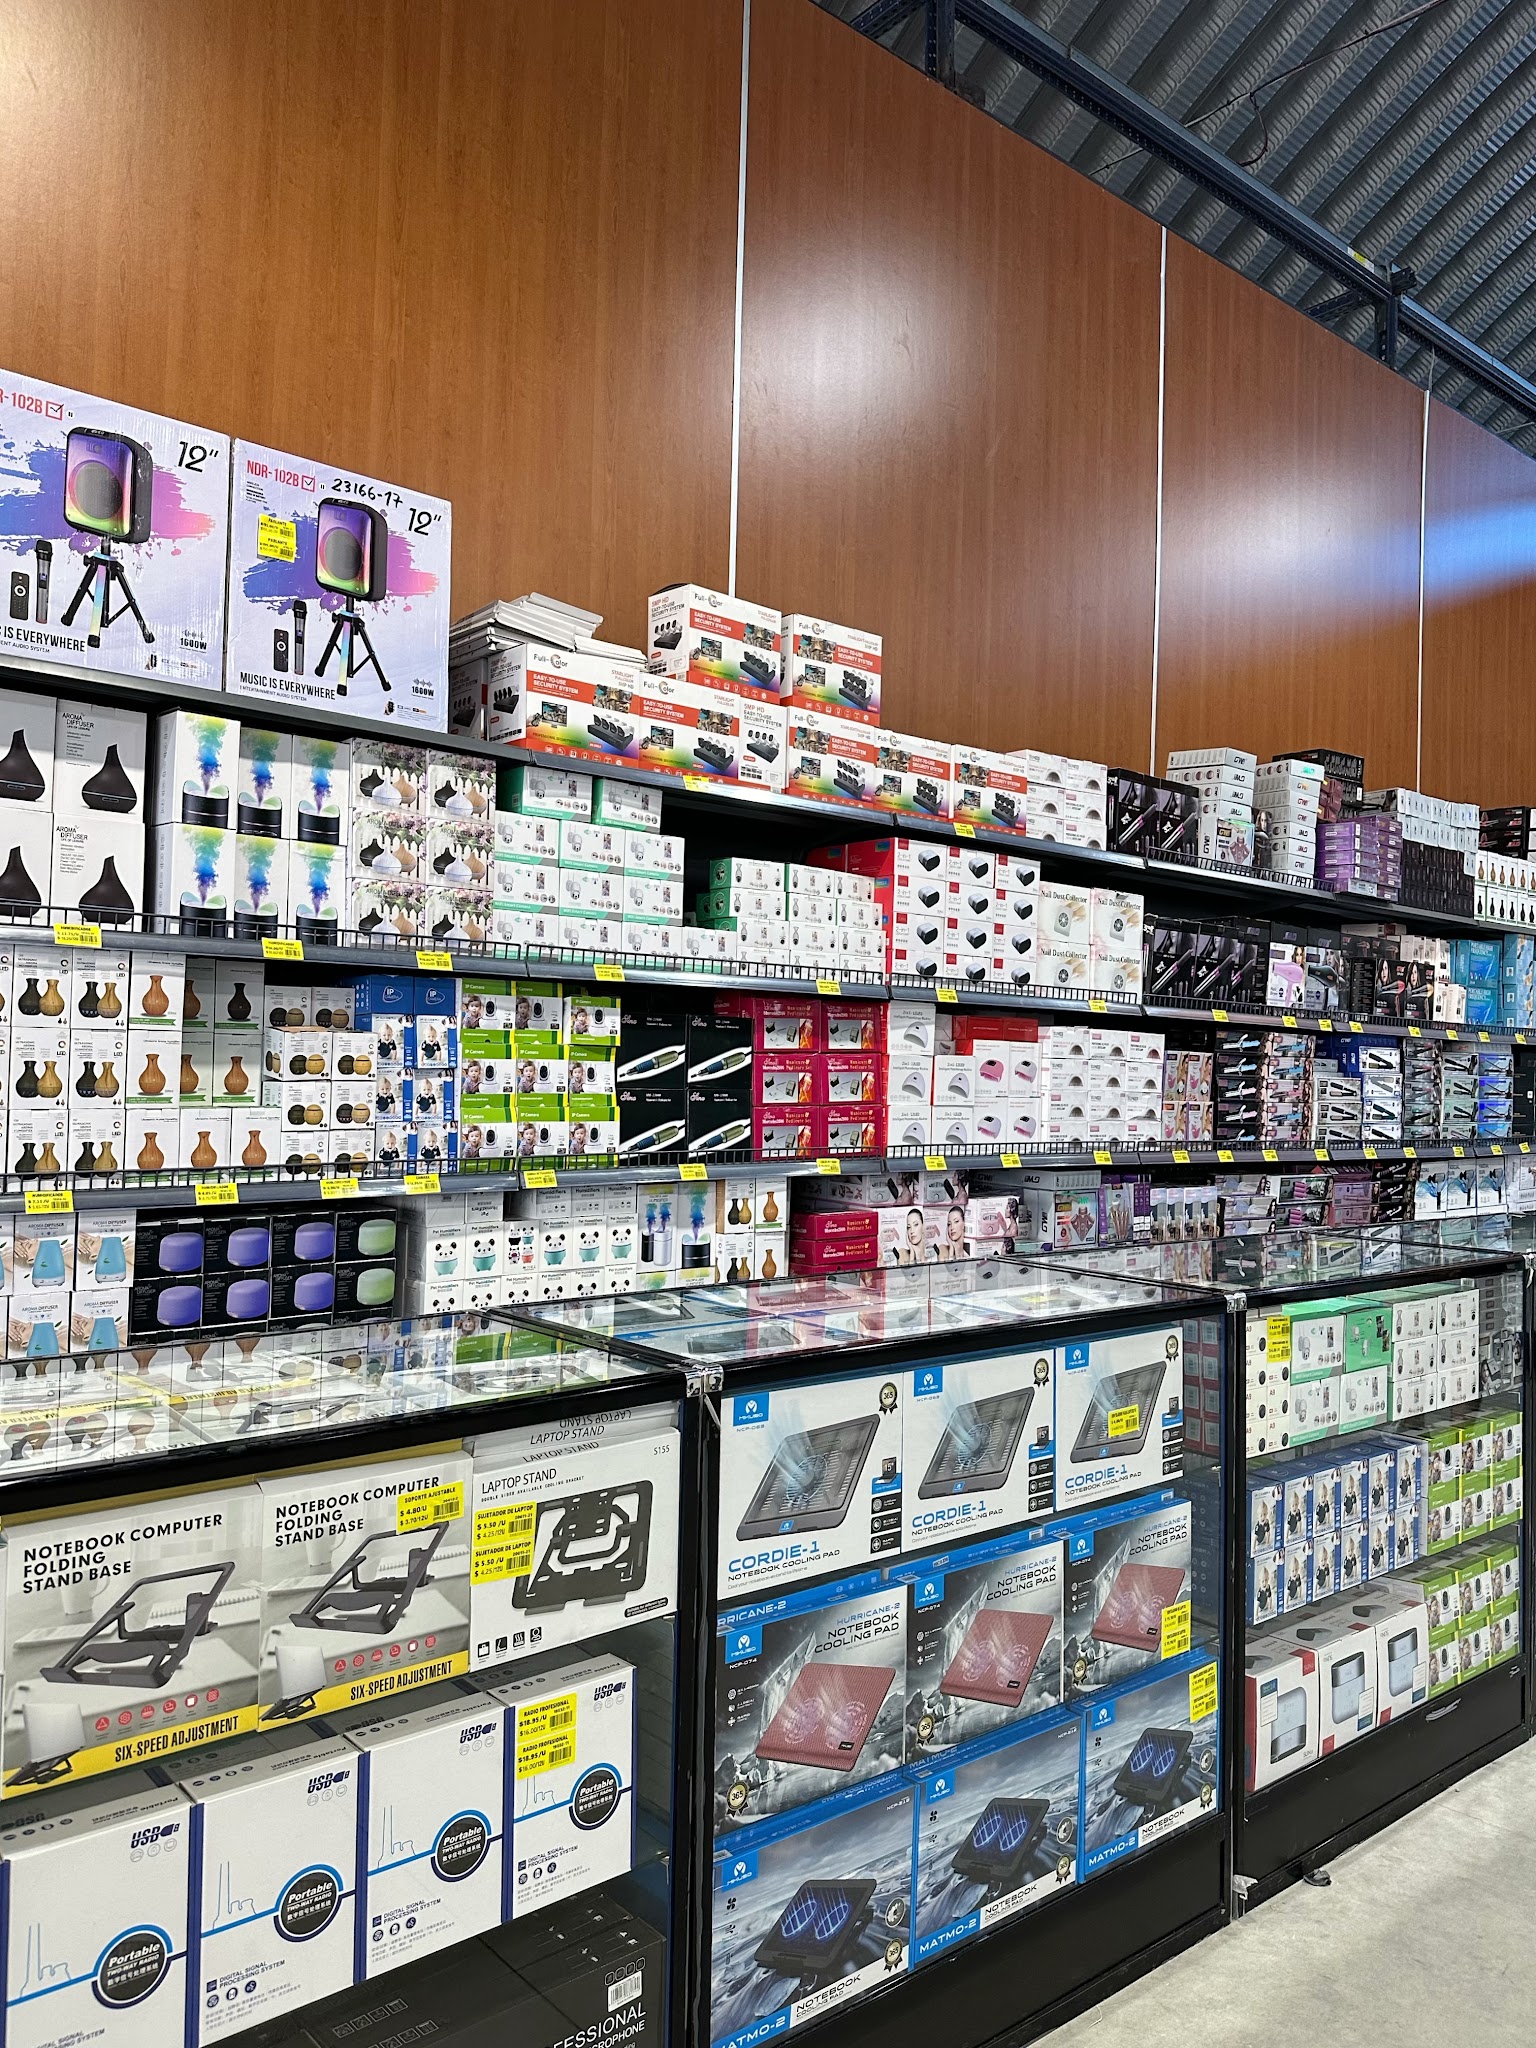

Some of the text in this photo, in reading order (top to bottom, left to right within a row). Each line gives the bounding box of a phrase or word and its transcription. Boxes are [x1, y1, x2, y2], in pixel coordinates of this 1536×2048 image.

[246, 459, 299, 487] NDR-102B
[331, 478, 403, 508] 23166-17
[694, 611, 722, 623] EASY-TO-USE
[694, 617, 732, 632] SECURITY SYSTEM
[4, 626, 86, 652] IS EVERYWHERE
[12, 642, 29, 650] AUDIO
[838, 646, 864, 658] EASY-TO-USE
[838, 652, 874, 667] SECURITY SYSTEM
[533, 674, 567, 686] EASY-TO-USE
[611, 669, 634, 679] STARLIGHT
[239, 685, 276, 696] ENTERTAINMENT
[240, 671, 336, 700] MUSIC IS EVERYWHERE
[411, 686, 435, 697] 1600W
[533, 679, 579, 695] SECURITY SYSTEM
[643, 700, 673, 711] EASY-TO-USE
[643, 705, 685, 719] SECURITY SYSTEM
[743, 710, 772, 721] EASY-TO-USE
[62, 712, 83, 721] AROMA
[66, 718, 95, 729] DIFFUSER
[743, 715, 782, 728] SECURITY SYSTEM
[832, 737, 858, 748] EASY-TO-USE
[832, 743, 867, 756] SECURITY SYSTEM
[990, 776, 1021, 788] SECURITY SYSTEM
[56, 825, 77, 834] AROMA
[60, 831, 88, 841] DIFFUSER
[1041, 889, 1088, 904] Nail Dust Collector
[1098, 897, 1141, 911] Nail Dust Collector
[1041, 948, 1088, 960] Nail Dust Collector
[1098, 953, 1141, 965] Nail Dust Collector
[559, 1409, 632, 1428] LAPTOP STAND
[530, 1425, 605, 1445] LAPTOP STAND
[522, 1441, 600, 1463] LAPTOP STAND
[481, 1468, 557, 1495] LAPTOP STAND
[1064, 1475, 1128, 1497] NOTEBOOK COOLING
[1065, 1464, 1127, 1489] CORDIE-1
[276, 1476, 440, 1519] NOTEBOOK COMPUTER
[404, 1487, 456, 1504] SOPORTE AJUSTABLE
[276, 1509, 343, 1533] FOLDING
[477, 1509, 507, 1520] SUJETADOR
[514, 1504, 533, 1513] LAPTOP
[911, 1500, 987, 1528] CORDIE-1
[911, 1507, 1004, 1537] NOTEBOOK COOLING PAD
[275, 1518, 364, 1548] STAND BASE
[1137, 1523, 1188, 1545] NOTEBOOK
[1143, 1515, 1188, 1534] HURRICANE-2
[24, 1513, 223, 1563] NOTEBOOK COMPUTER
[1129, 1531, 1188, 1556] COOLING PAD
[475, 1541, 532, 1557] SUJETADOR LAPTOP
[728, 1540, 820, 1574] CORDIE-1
[23, 1551, 106, 1579] FOLDING
[728, 1563, 781, 1583] NOTEBOOK
[782, 1554, 821, 1570] COOLING
[822, 1549, 841, 1560] PAD
[1004, 1555, 1058, 1577] HURRICANE-2
[23, 1560, 132, 1594] STAND BASE
[997, 1564, 1057, 1589] NOTEBOOK
[986, 1573, 1057, 1602] COOLING PAD
[836, 1602, 901, 1626] HURRICANE-2
[827, 1611, 900, 1640] NOTEBOOK
[814, 1621, 900, 1654] COOLING PAD
[350, 1660, 453, 1701] SIX-SPEED ADJUSTMENT
[523, 1708, 539, 1717] RADIO
[115, 1715, 239, 1763] SIX-SPEED ADJUSTMENT
[522, 1744, 538, 1753] RADIO
[579, 1777, 615, 1796] Portable
[600, 1787, 614, 1797] RADIO
[1141, 1807, 1186, 1834] NOTEBOOK
[442, 1835, 482, 1853] TWO-WAY RADIO
[443, 1825, 482, 1846] Portable
[527, 1845, 578, 1869] PROCESSING SYSTEM
[548, 1845, 565, 1857] SIGNAL
[1088, 1836, 1136, 1866] MATMO-2
[286, 1891, 332, 1912] TWO-WAY RADIO
[288, 1880, 333, 1904] Portable
[984, 1884, 1038, 1914] NOTEBOOK
[383, 1898, 425, 1919] DIGITAL SIGNAL
[383, 1898, 441, 1925] PROCESSING SYSTEM
[920, 1917, 977, 1954] MATMO-2
[108, 1942, 161, 1967] Portable
[107, 1953, 160, 1978] TWO-WAY RADIO
[219, 1961, 268, 1984] DIGITAL SIGNAL
[219, 1960, 286, 1989] PROCESSING SYSTEM
[796, 1974, 862, 2013] NOTEBOOK
[796, 1997, 829, 2018] COOLING
[58, 2030, 85, 2044] SIGNAL
